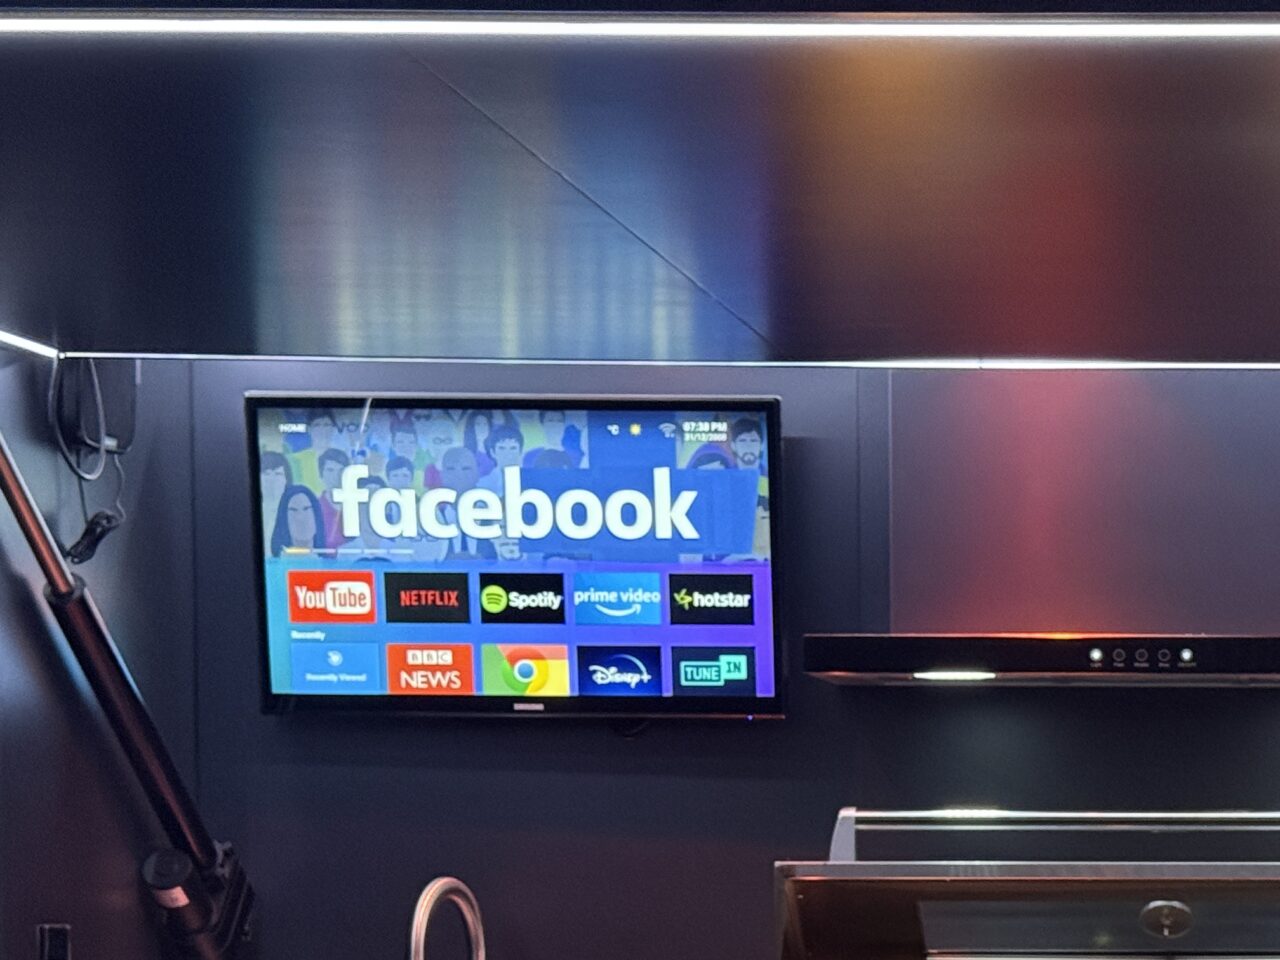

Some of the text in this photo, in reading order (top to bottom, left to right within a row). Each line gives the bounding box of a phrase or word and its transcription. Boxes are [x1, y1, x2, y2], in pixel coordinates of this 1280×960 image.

[279, 423, 307, 433] HOME
[711, 421, 728, 432] PM
[332, 465, 700, 541] facebook
[294, 585, 367, 609] YouTube
[400, 589, 459, 608] NETFLIX
[508, 591, 563, 610] Spotify
[574, 587, 661, 606] prime video
[692, 591, 751, 608] hotstar
[406, 649, 453, 665] BBC
[684, 666, 721, 682] TUNE
[725, 660, 742, 674] IN
[399, 670, 462, 690] NEWS
